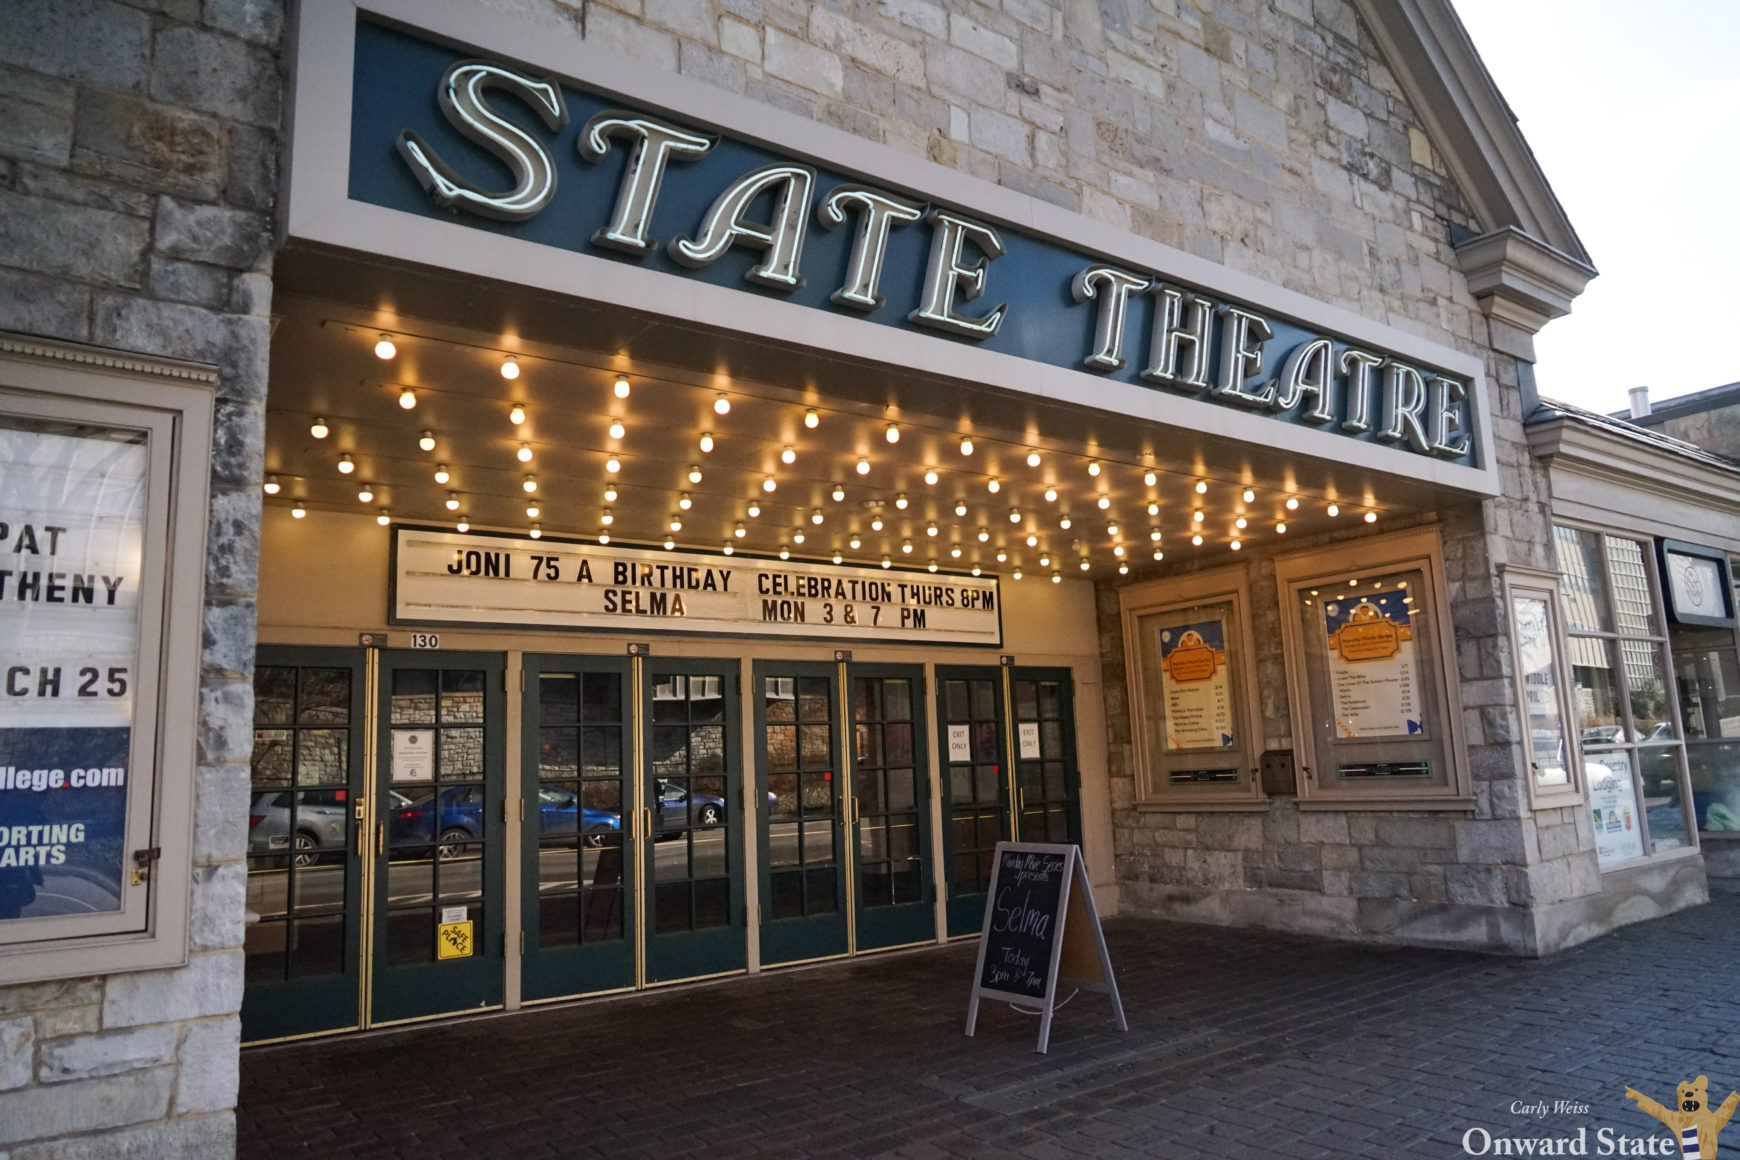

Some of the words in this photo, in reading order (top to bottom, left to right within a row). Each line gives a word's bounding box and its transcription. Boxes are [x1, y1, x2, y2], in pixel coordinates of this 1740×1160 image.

[396, 57, 1007, 340] STATE
[1071, 264, 1472, 461] THEATRE
[447, 549, 511, 578] JONI
[530, 555, 560, 581] 75
[576, 559, 593, 583] A
[613, 561, 732, 592] BIRTHDAY
[758, 573, 892, 604] CELEBRATION
[898, 583, 955, 608] THURS
[961, 589, 994, 610] 8PM
[604, 589, 686, 616] SELMA
[762, 599, 806, 623] MON
[823, 602, 834, 624] 3
[844, 604, 857, 625] &
[871, 606, 881, 626] 7
[900, 608, 926, 629] PM
[411, 634, 439, 648] 130
[6, 665, 62, 697] CH
[77, 666, 128, 697] 25
[0, 823, 85, 847] ORTING
[0, 845, 67, 867] ARTS
[993, 886, 1050, 940] Selma
[450, 926, 469, 943] SAFE
[1002, 947, 1030, 976] Today
